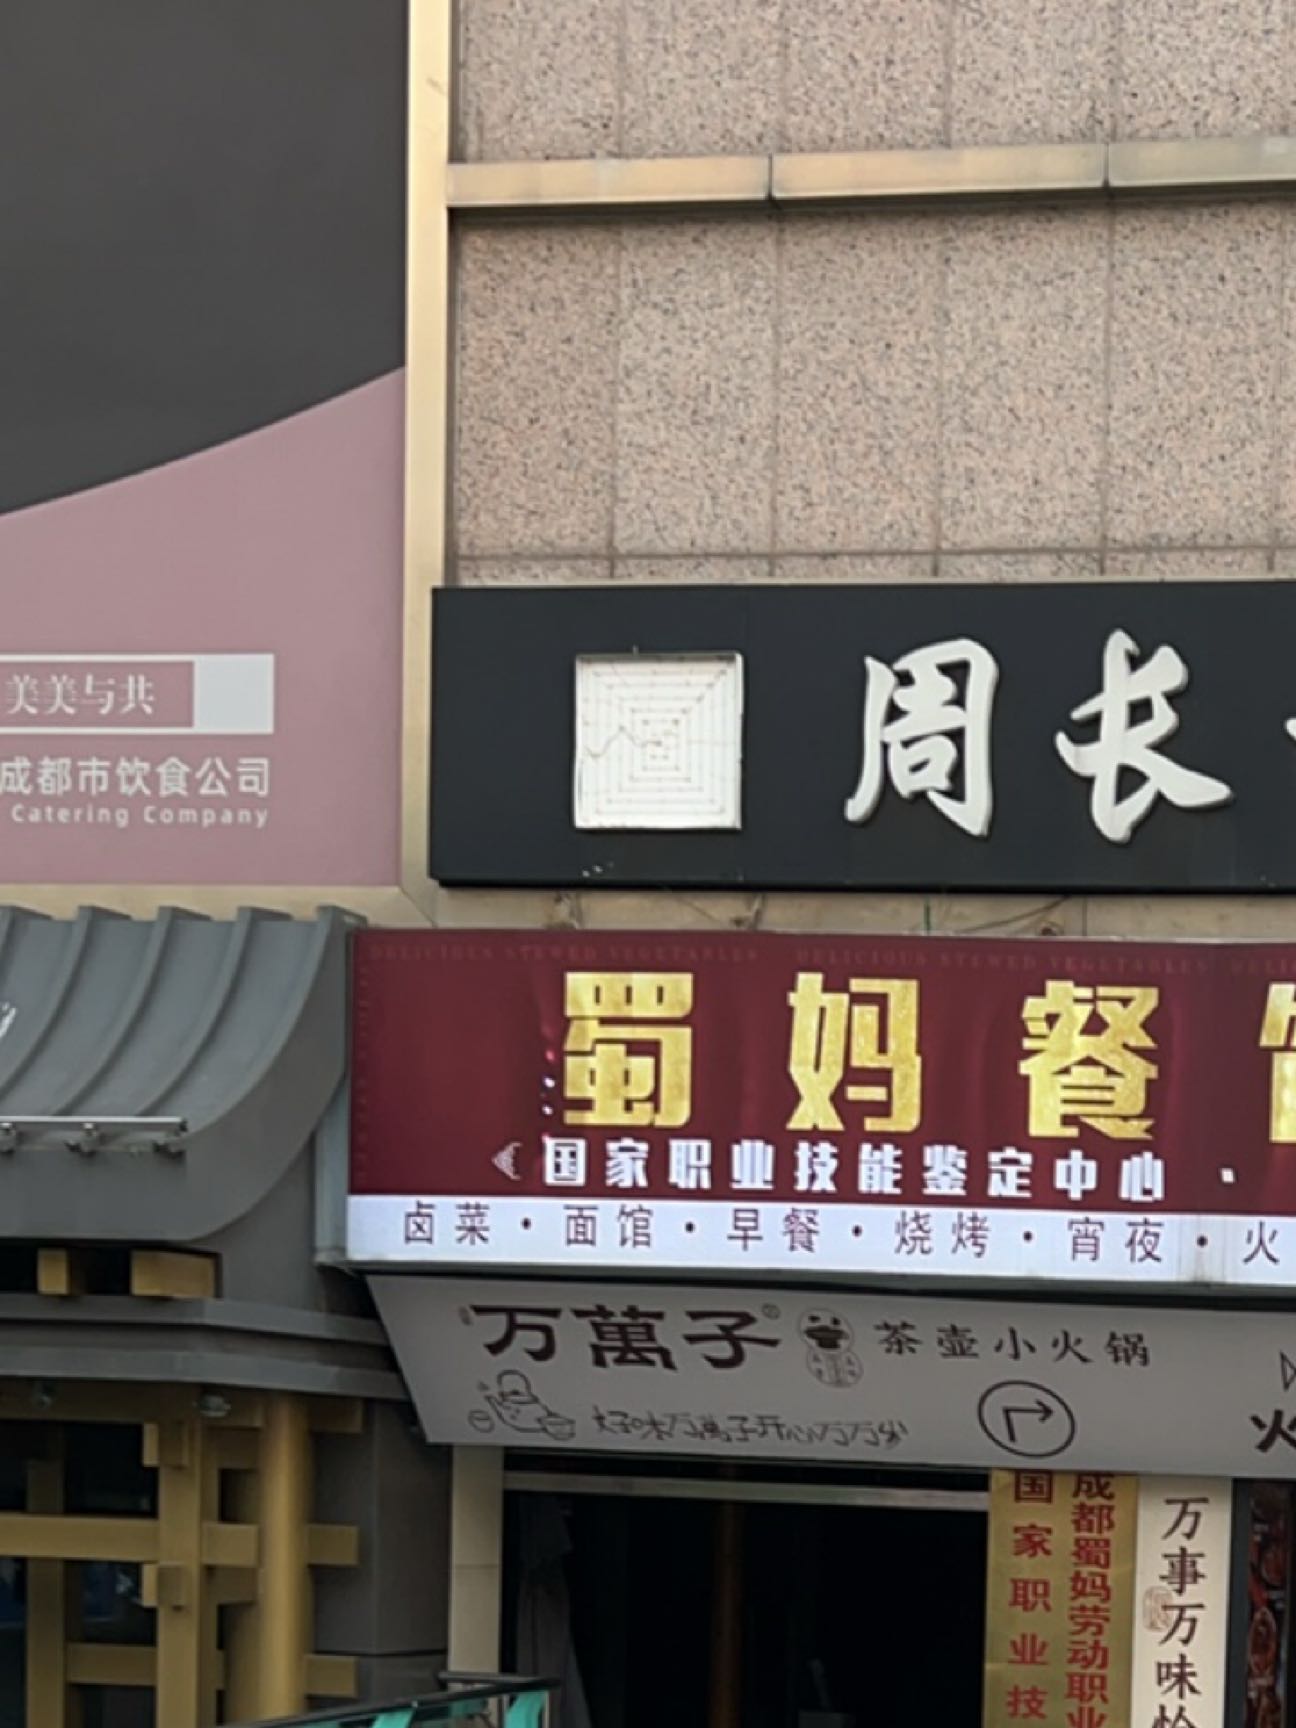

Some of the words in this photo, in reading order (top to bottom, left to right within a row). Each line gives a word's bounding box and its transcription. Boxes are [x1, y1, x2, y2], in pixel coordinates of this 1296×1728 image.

[6, 674, 155, 715] 美美与共
[0, 756, 270, 796] 成都市饮食公司
[11, 804, 130, 828] Catering
[143, 804, 269, 829] Company
[544, 1138, 1166, 1202] 国家职业技能鉴定中心
[469, 1304, 781, 1372] 万萬子
[874, 1321, 1151, 1368] 茶壶小火锅
